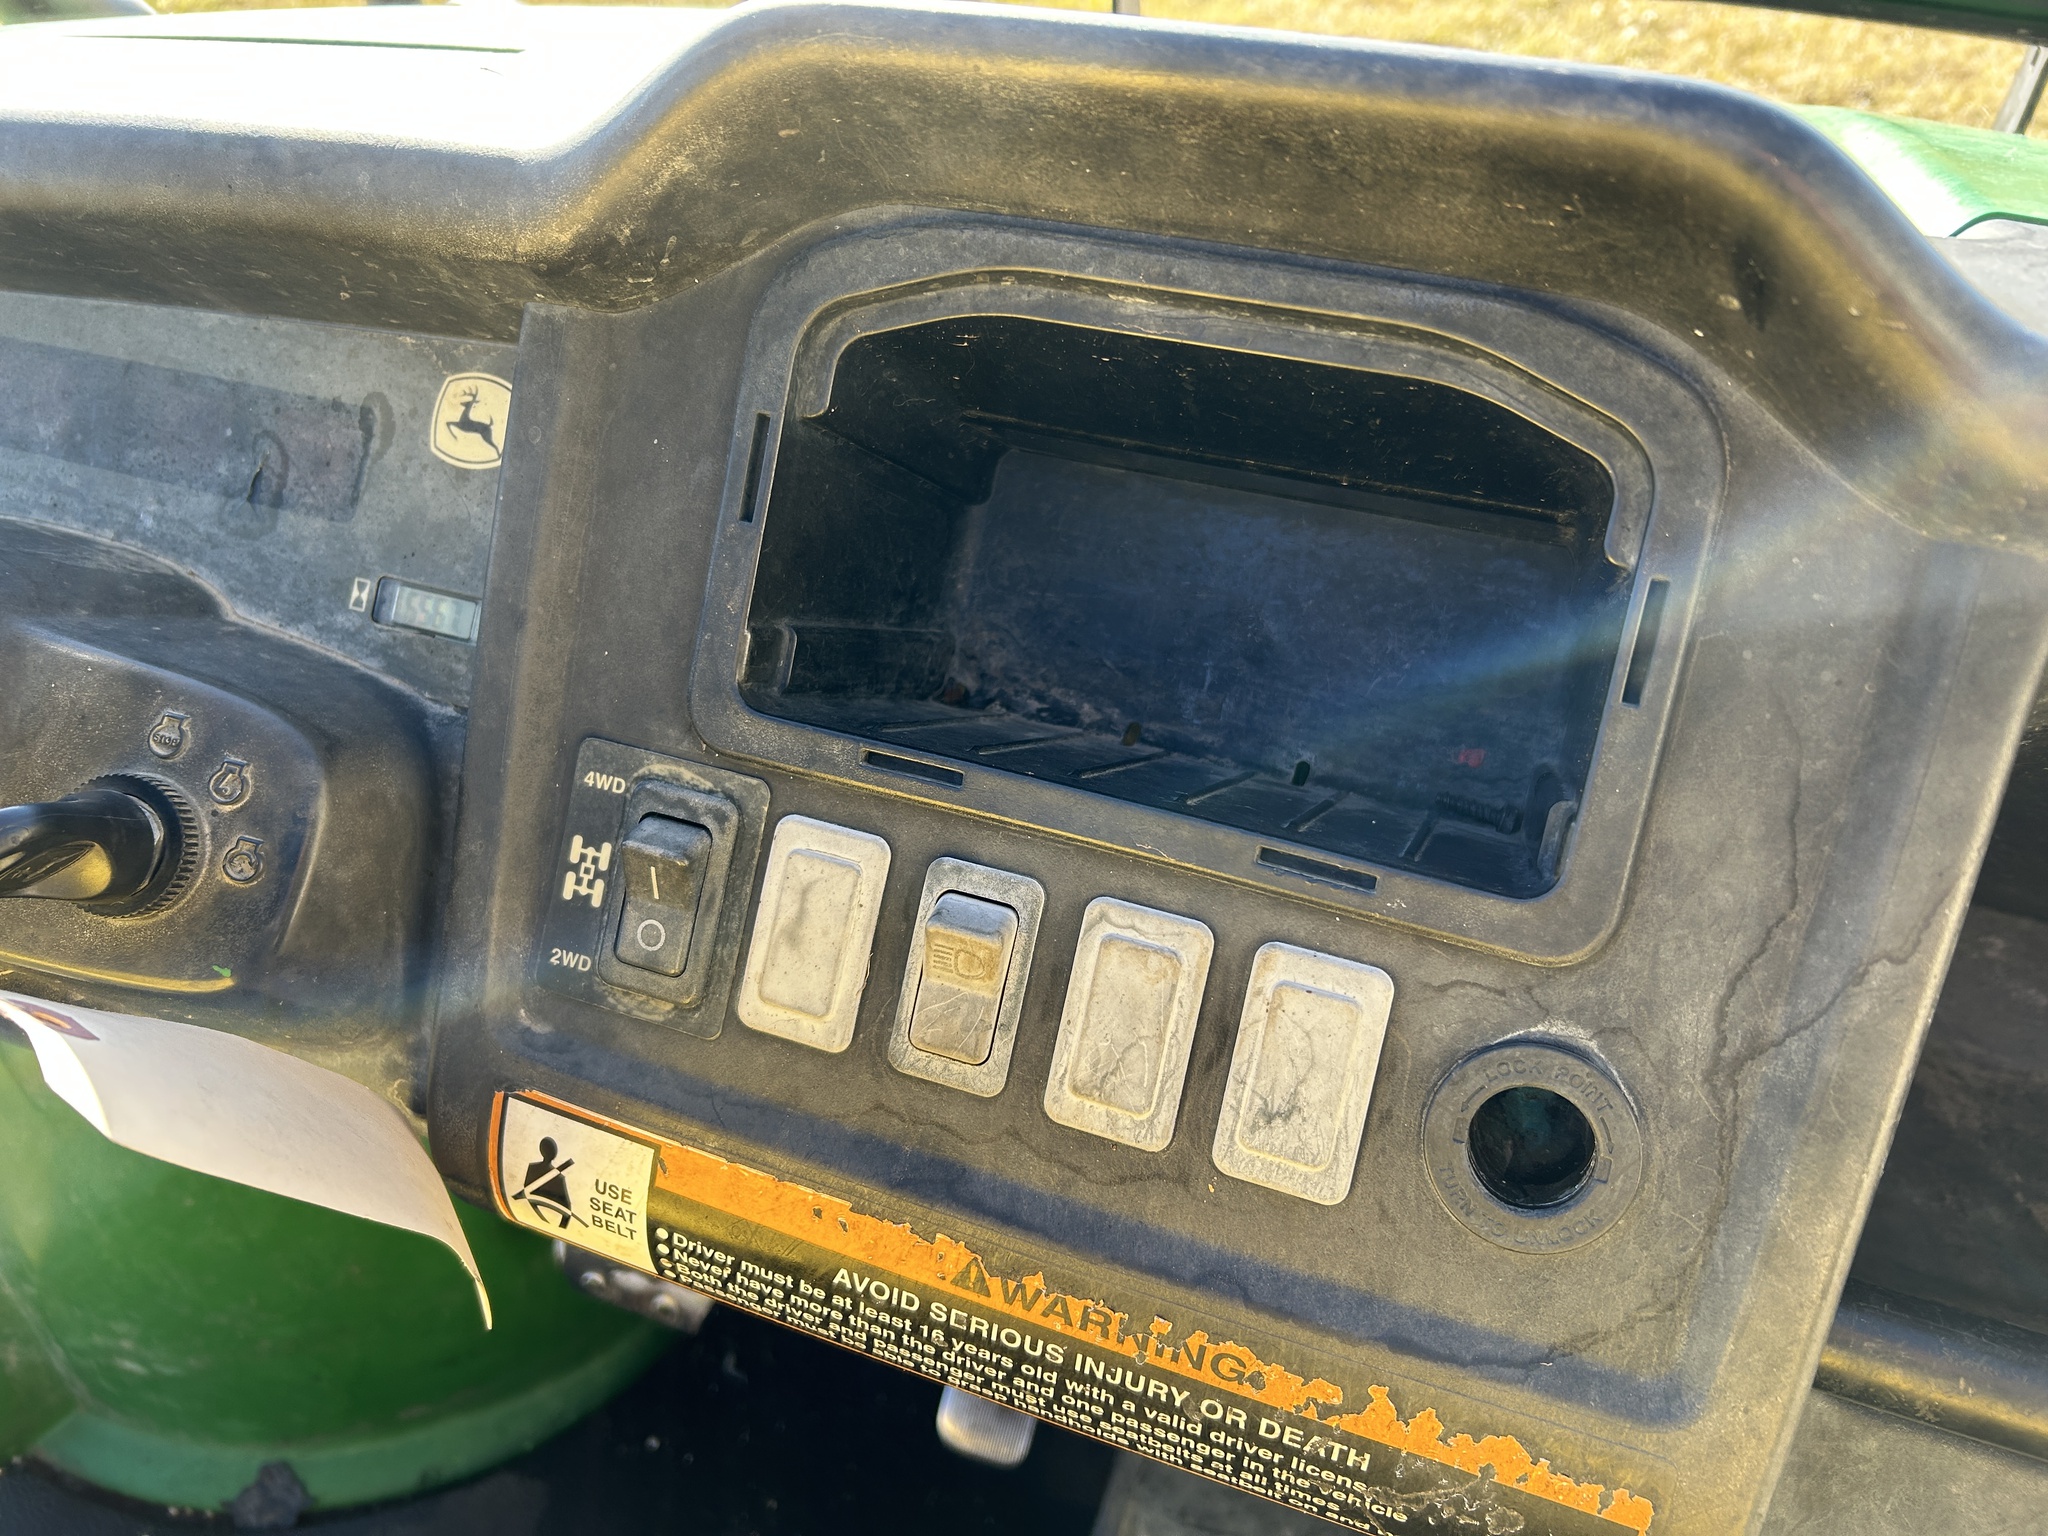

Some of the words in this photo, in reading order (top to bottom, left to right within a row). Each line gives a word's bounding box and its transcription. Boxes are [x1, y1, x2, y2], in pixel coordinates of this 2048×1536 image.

[153, 733, 180, 747] STOP
[584, 771, 626, 794] 4WD
[550, 948, 592, 972] 2WD
[1485, 1059, 1543, 1083] LOCK
[1555, 1066, 1613, 1112] POINT
[590, 1197, 637, 1224] SEAT
[595, 1179, 632, 1205] USE
[1440, 1164, 1476, 1217] TURN
[1482, 1212, 1506, 1237] TO
[1515, 1209, 1603, 1245] UNLOCK
[592, 1214, 637, 1240] BELT
[672, 1232, 735, 1265] Driver
[740, 1260, 794, 1288] must
[800, 1279, 826, 1300] be
[832, 1294, 852, 1310] at
[859, 1302, 912, 1331] least
[919, 1325, 946, 1345] 16
[951, 1337, 1013, 1368] years
[1020, 1364, 1057, 1384] old
[1065, 1379, 1114, 1404] with
[1122, 1400, 1136, 1413] a
[1144, 1406, 1202, 1436] valid
[1210, 1431, 1284, 1463] driver
[1291, 1456, 1370, 1493] licens
[1000, 1277, 1248, 1385] WARNING
[674, 1249, 732, 1278] Never
[736, 1272, 784, 1298] have
[790, 1294, 843, 1321] more
[849, 1315, 895, 1340] than
[902, 1334, 936, 1355] the
[942, 1352, 1007, 1379] driver
[1012, 1376, 1055, 1398] and
[1061, 1395, 1104, 1416] one
[1111, 1411, 1236, 1461] passenger
[1243, 1456, 1264, 1473] in
[1272, 1467, 1310, 1488] the
[1319, 1484, 1408, 1522] vehicle
[676, 1262, 722, 1288] Both
[727, 1282, 759, 1301] the
[764, 1298, 823, 1325] driver
[829, 1322, 867, 1342] and
[873, 1338, 985, 1384] passenger
[991, 1382, 1046, 1406] must
[1053, 1403, 1092, 1423] use
[1100, 1421, 1203, 1463] seatbelts
[1211, 1461, 1234, 1474] at
[1240, 1471, 1267, 1486] all
[1274, 1482, 1340, 1511] times
[832, 1268, 920, 1311] AVOID
[930, 1302, 1064, 1364] SERIOUS
[1075, 1353, 1190, 1407] INJURY
[1200, 1399, 1247, 1430] OR
[1258, 1418, 1370, 1472] DEATH
[786, 1315, 837, 1339] must
[841, 1335, 866, 1350] be
[872, 1347, 915, 1368] able
[920, 1364, 941, 1377] to
[947, 1376, 1007, 1402] grasp
[1013, 1399, 1129, 1446] handholds
[1136, 1443, 1183, 1464] with
[1190, 1463, 1283, 1500] seatbelt
[1289, 1498, 1318, 1512] on
[1325, 1511, 1371, 1530] and
